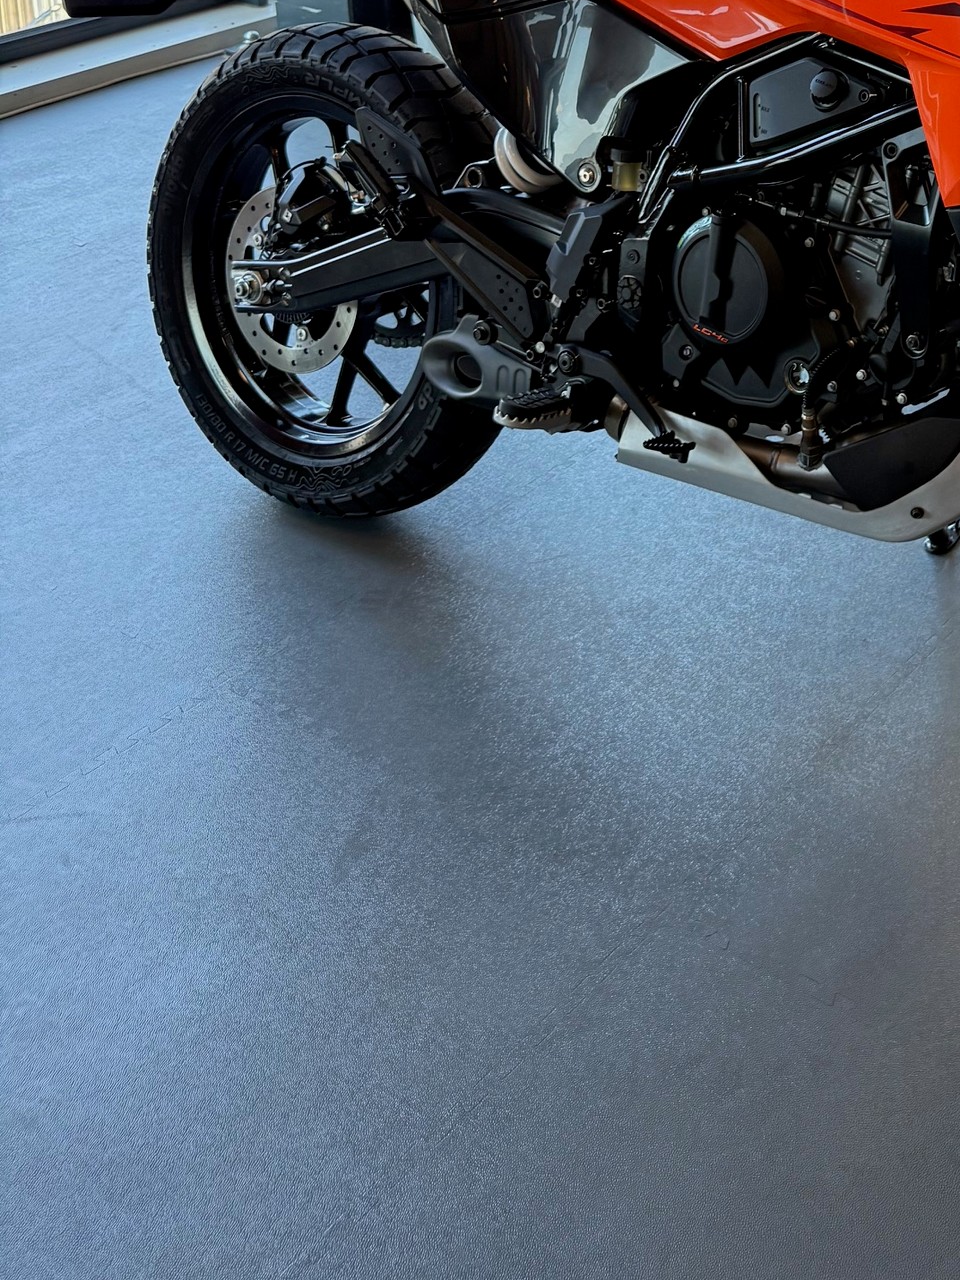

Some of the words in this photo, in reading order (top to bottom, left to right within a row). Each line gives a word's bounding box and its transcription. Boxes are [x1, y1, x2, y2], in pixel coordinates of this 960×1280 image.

[304, 72, 366, 107] MPLR
[233, 440, 247, 452] 17
[245, 449, 270, 470] M/C
